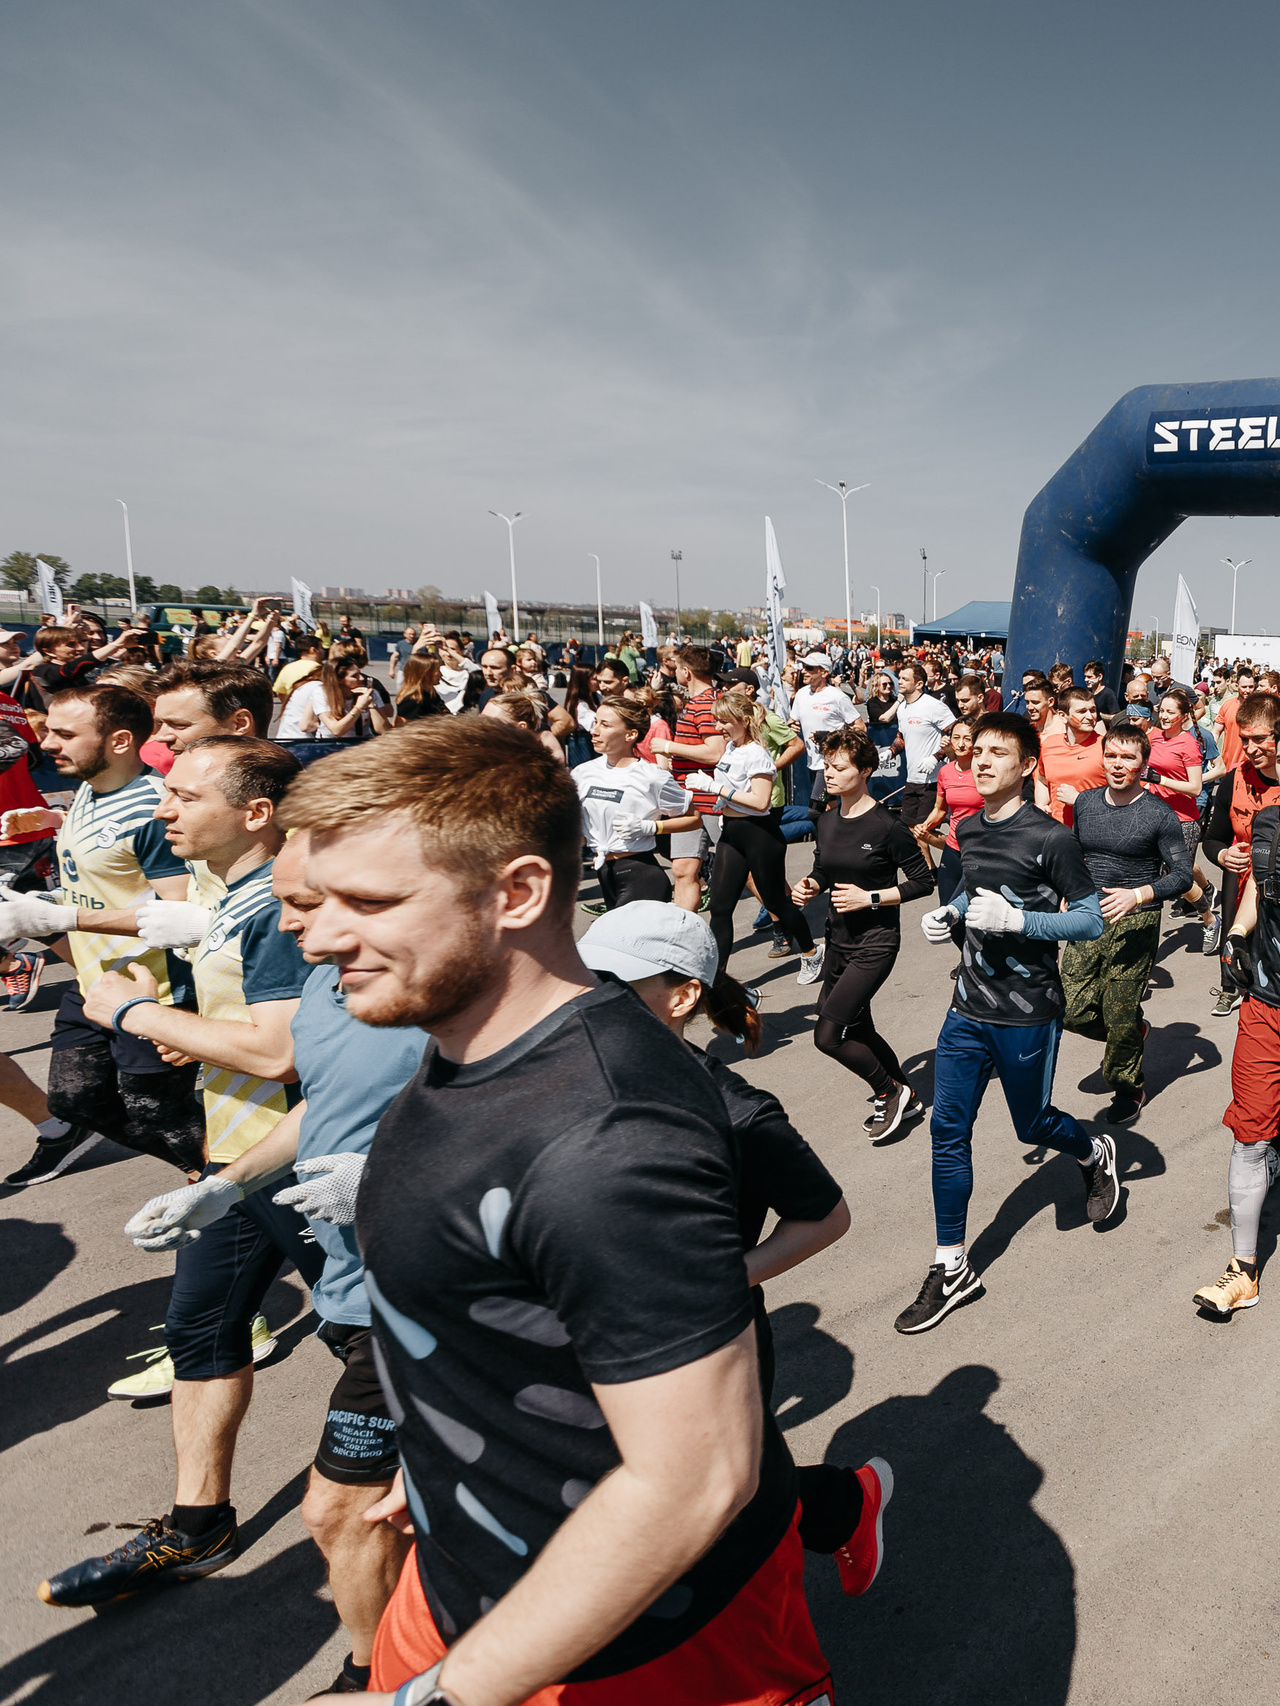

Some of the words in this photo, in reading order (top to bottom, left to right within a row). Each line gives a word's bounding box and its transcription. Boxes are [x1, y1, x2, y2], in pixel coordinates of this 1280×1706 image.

[96, 819, 122, 849] 5
[62, 887, 105, 910] ТЕПЬ
[327, 1409, 366, 1426] PACIFIC
[368, 1416, 397, 1431] SUR
[342, 1426, 374, 1438] BEACH
[332, 1445, 358, 1458] SINCE
